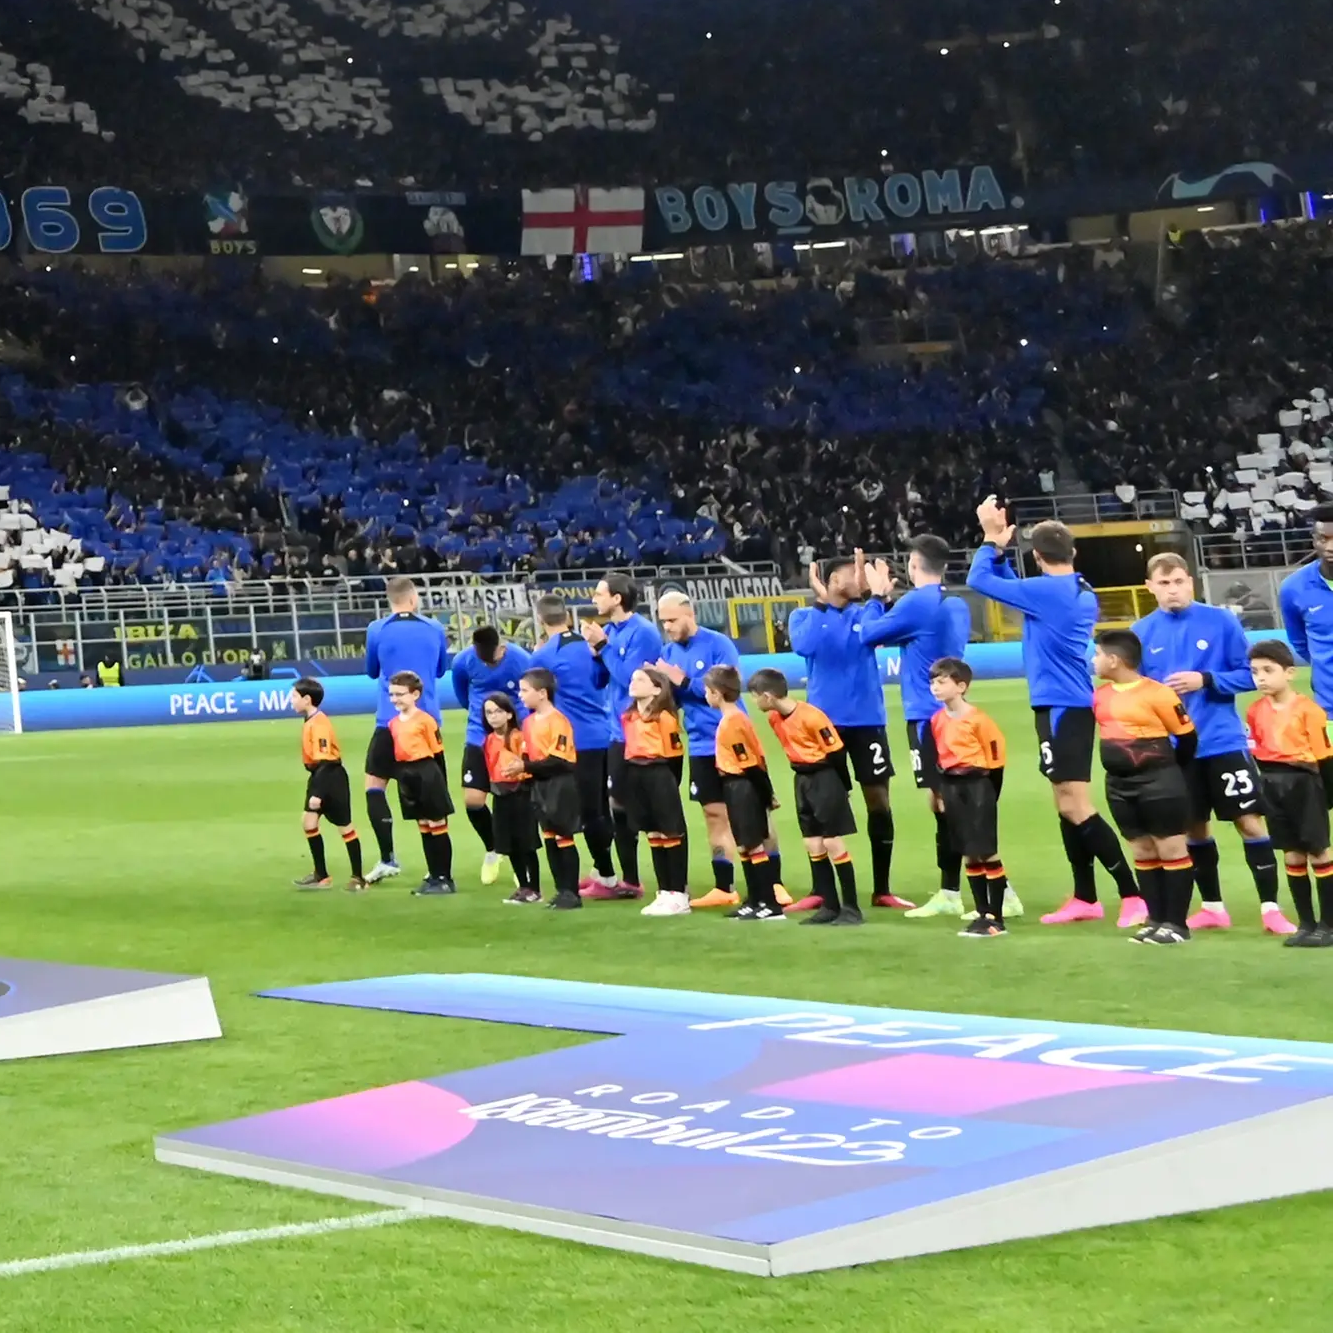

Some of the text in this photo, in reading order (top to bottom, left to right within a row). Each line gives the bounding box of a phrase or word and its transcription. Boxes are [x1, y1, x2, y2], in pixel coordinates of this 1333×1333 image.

[655, 164, 1007, 235] BOYS ROMA
[209, 239, 257, 255] BOYS
[113, 623, 199, 641] IBIZA
[128, 648, 267, 670] GALLO D'OR
[169, 690, 239, 716] PEACE
[258, 688, 295, 712] МИ
[869, 742, 885, 765] 2
[1220, 769, 1253, 797] 23
[687, 1012, 1333, 1085] PEACE
[574, 1082, 963, 1140] ROAD TO
